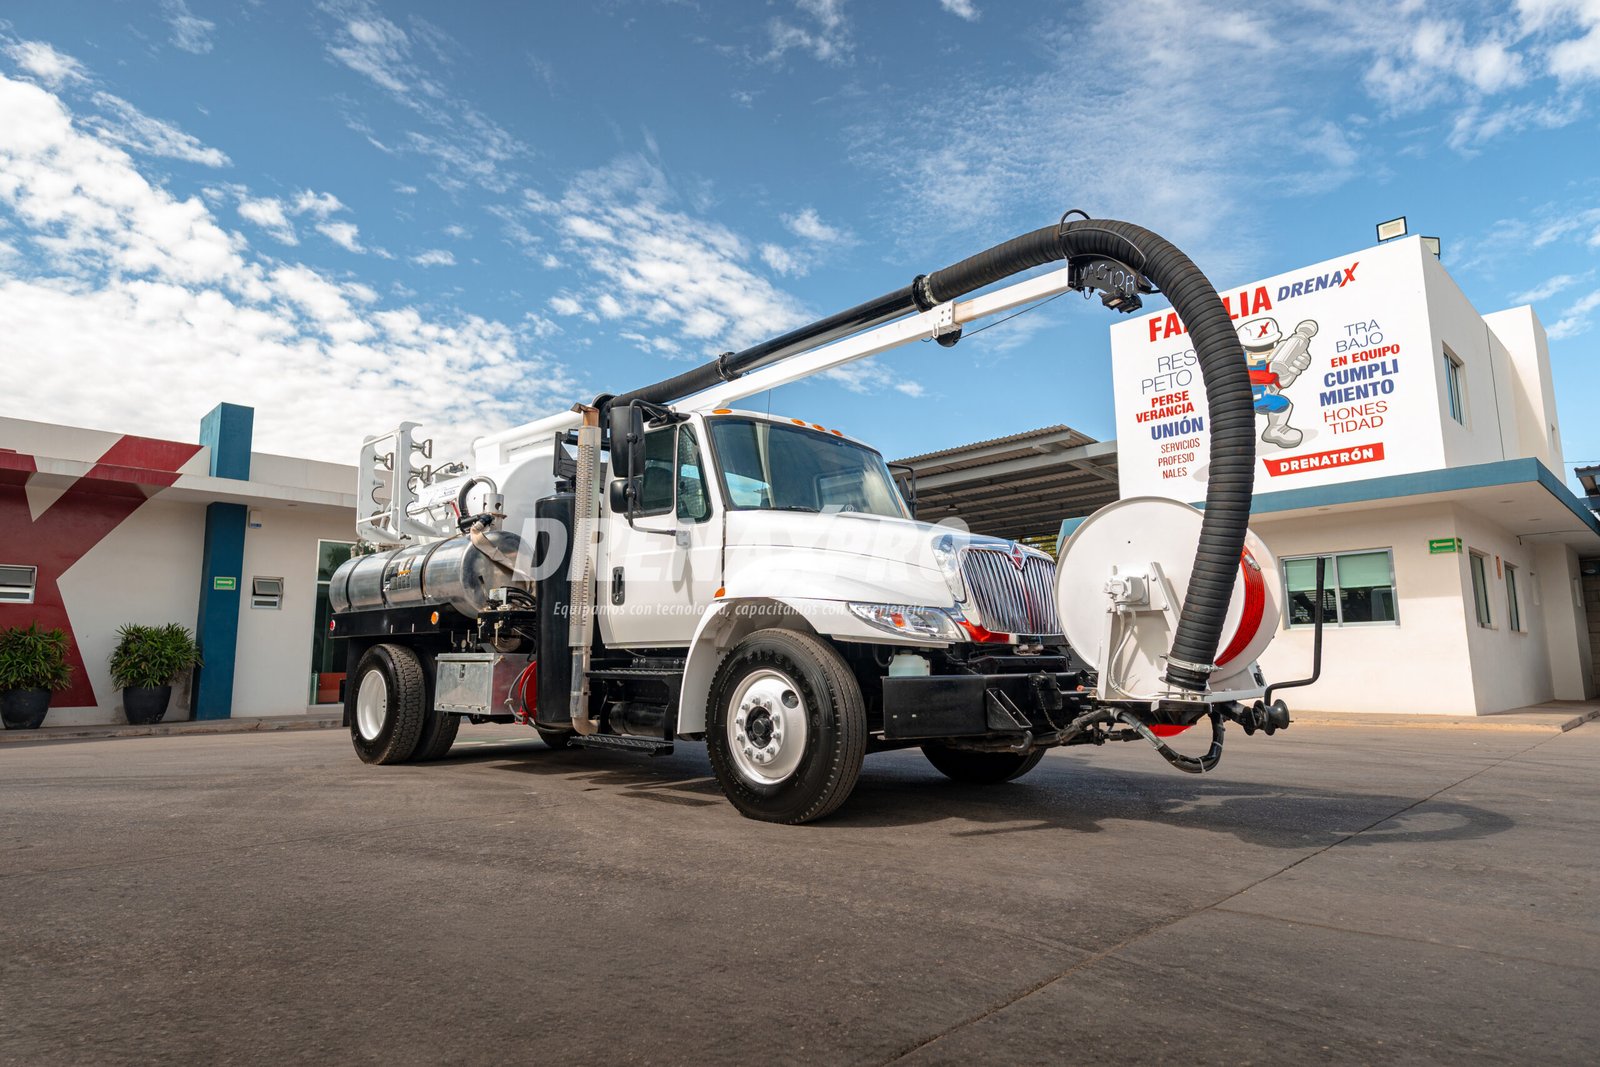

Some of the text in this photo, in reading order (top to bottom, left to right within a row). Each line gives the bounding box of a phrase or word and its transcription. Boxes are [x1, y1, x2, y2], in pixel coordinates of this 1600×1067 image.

[1149, 261, 1359, 342] FALIA DRENAX
[1344, 319, 1381, 337] TRA
[1335, 332, 1384, 353] BAJO
[1157, 349, 1197, 373] RES
[1330, 343, 1400, 368] EN EQUIPO
[1141, 369, 1193, 395] PETO
[1323, 358, 1399, 388] CUMPLI
[1151, 390, 1190, 408] PERSE
[1319, 379, 1395, 407] MIENTO
[1135, 402, 1195, 423] VERANCIA
[1323, 400, 1388, 423] HONES
[1150, 415, 1204, 441] UNIÓN
[1329, 415, 1384, 435] TIDAD
[1160, 437, 1201, 454] SERVICIOS
[1158, 452, 1195, 467] PROFESIO
[1279, 447, 1374, 473] DRENATRÓN
[1162, 467, 1188, 480] NALES
